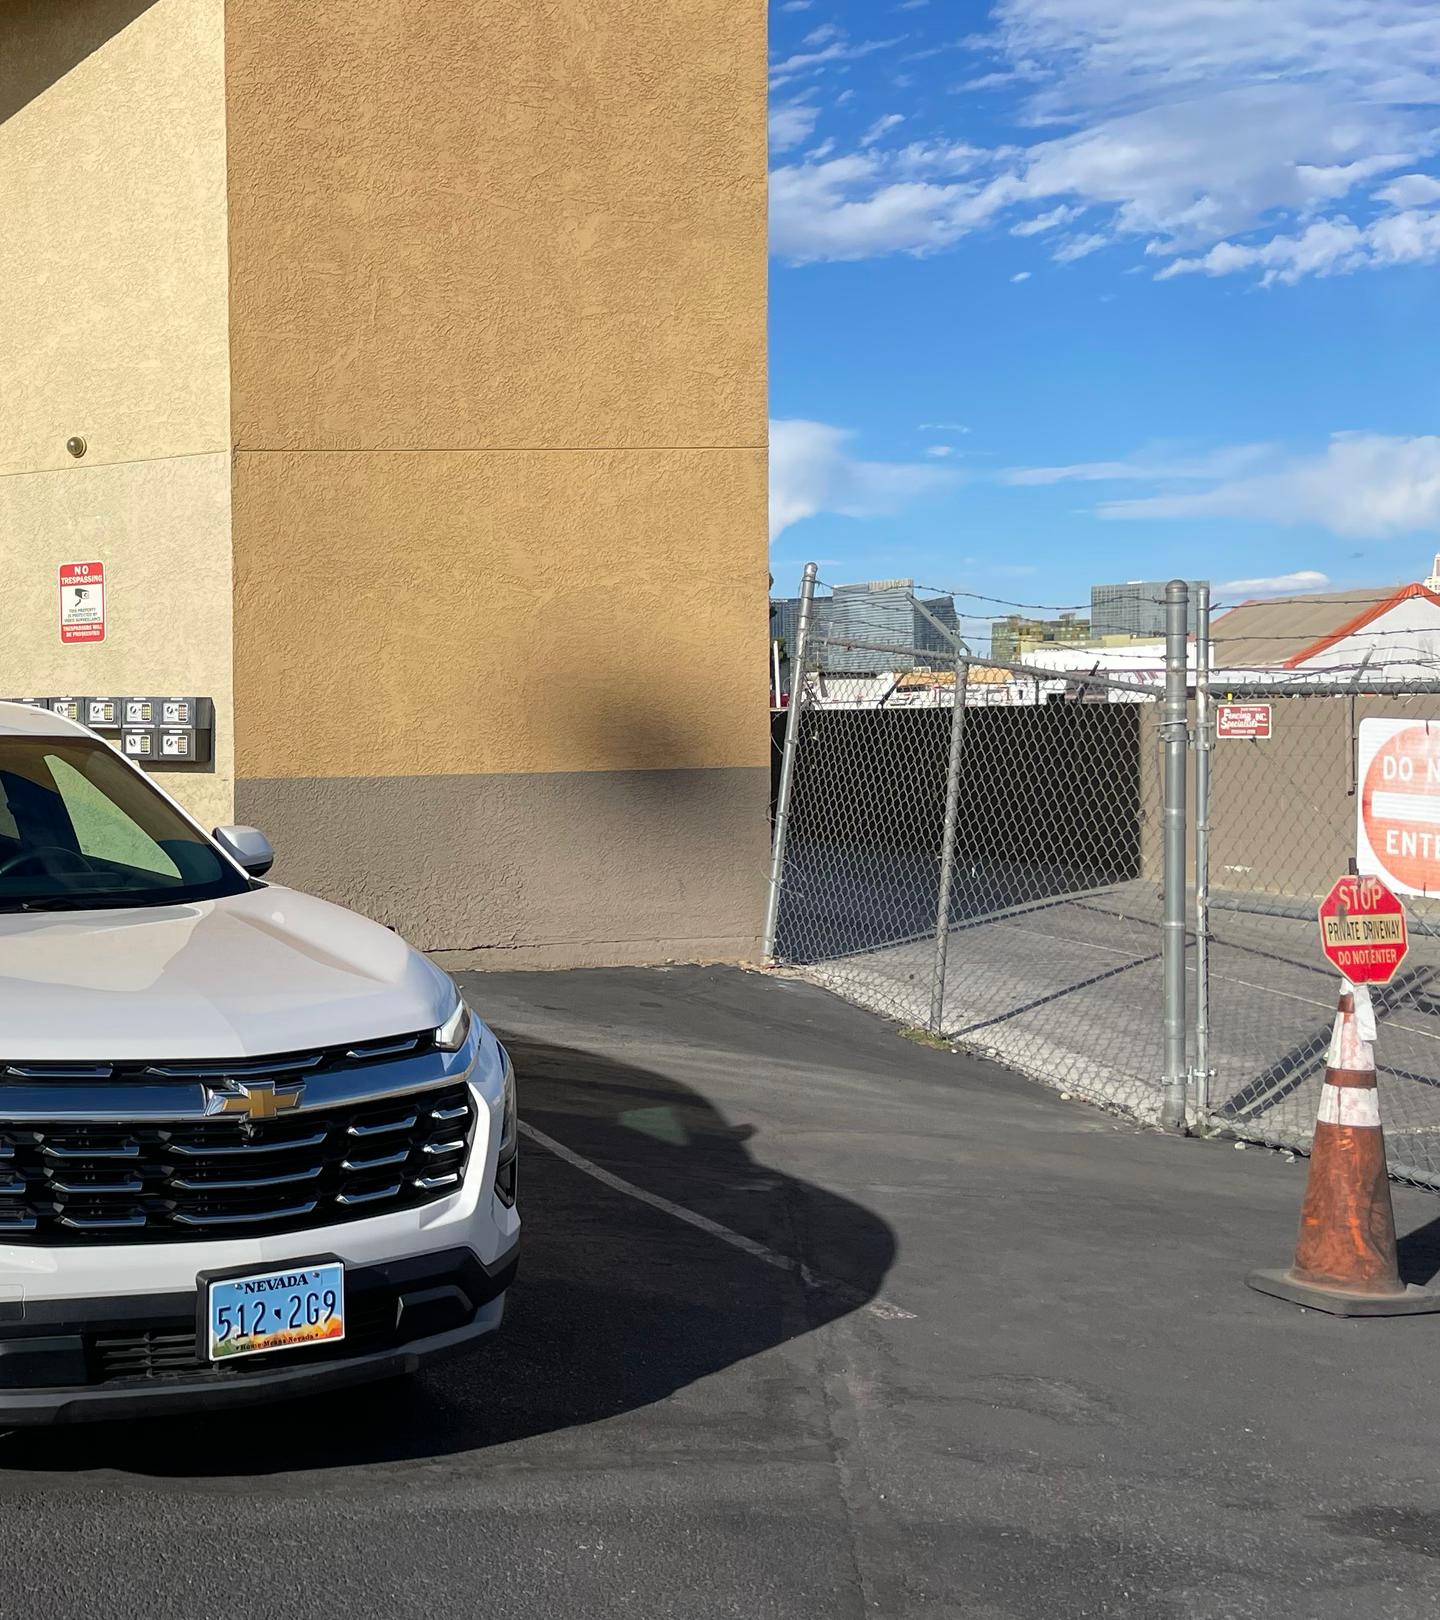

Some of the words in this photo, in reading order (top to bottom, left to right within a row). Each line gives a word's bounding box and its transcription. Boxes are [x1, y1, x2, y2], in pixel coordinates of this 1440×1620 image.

[60, 575, 103, 585] TRESPASSING
[74, 565, 89, 575] NO
[1383, 755, 1413, 781] DO
[1339, 884, 1382, 911] STOP
[1327, 921, 1361, 941] PRIVATE
[1362, 919, 1401, 940] DRIVEWAY
[1337, 950, 1352, 966] DO
[1352, 949, 1370, 965] NOT
[1370, 948, 1398, 964] ENTER
[244, 1273, 309, 1295] NEVADA
[217, 1300, 267, 1342] 512
[287, 1289, 337, 1331] 2G9
